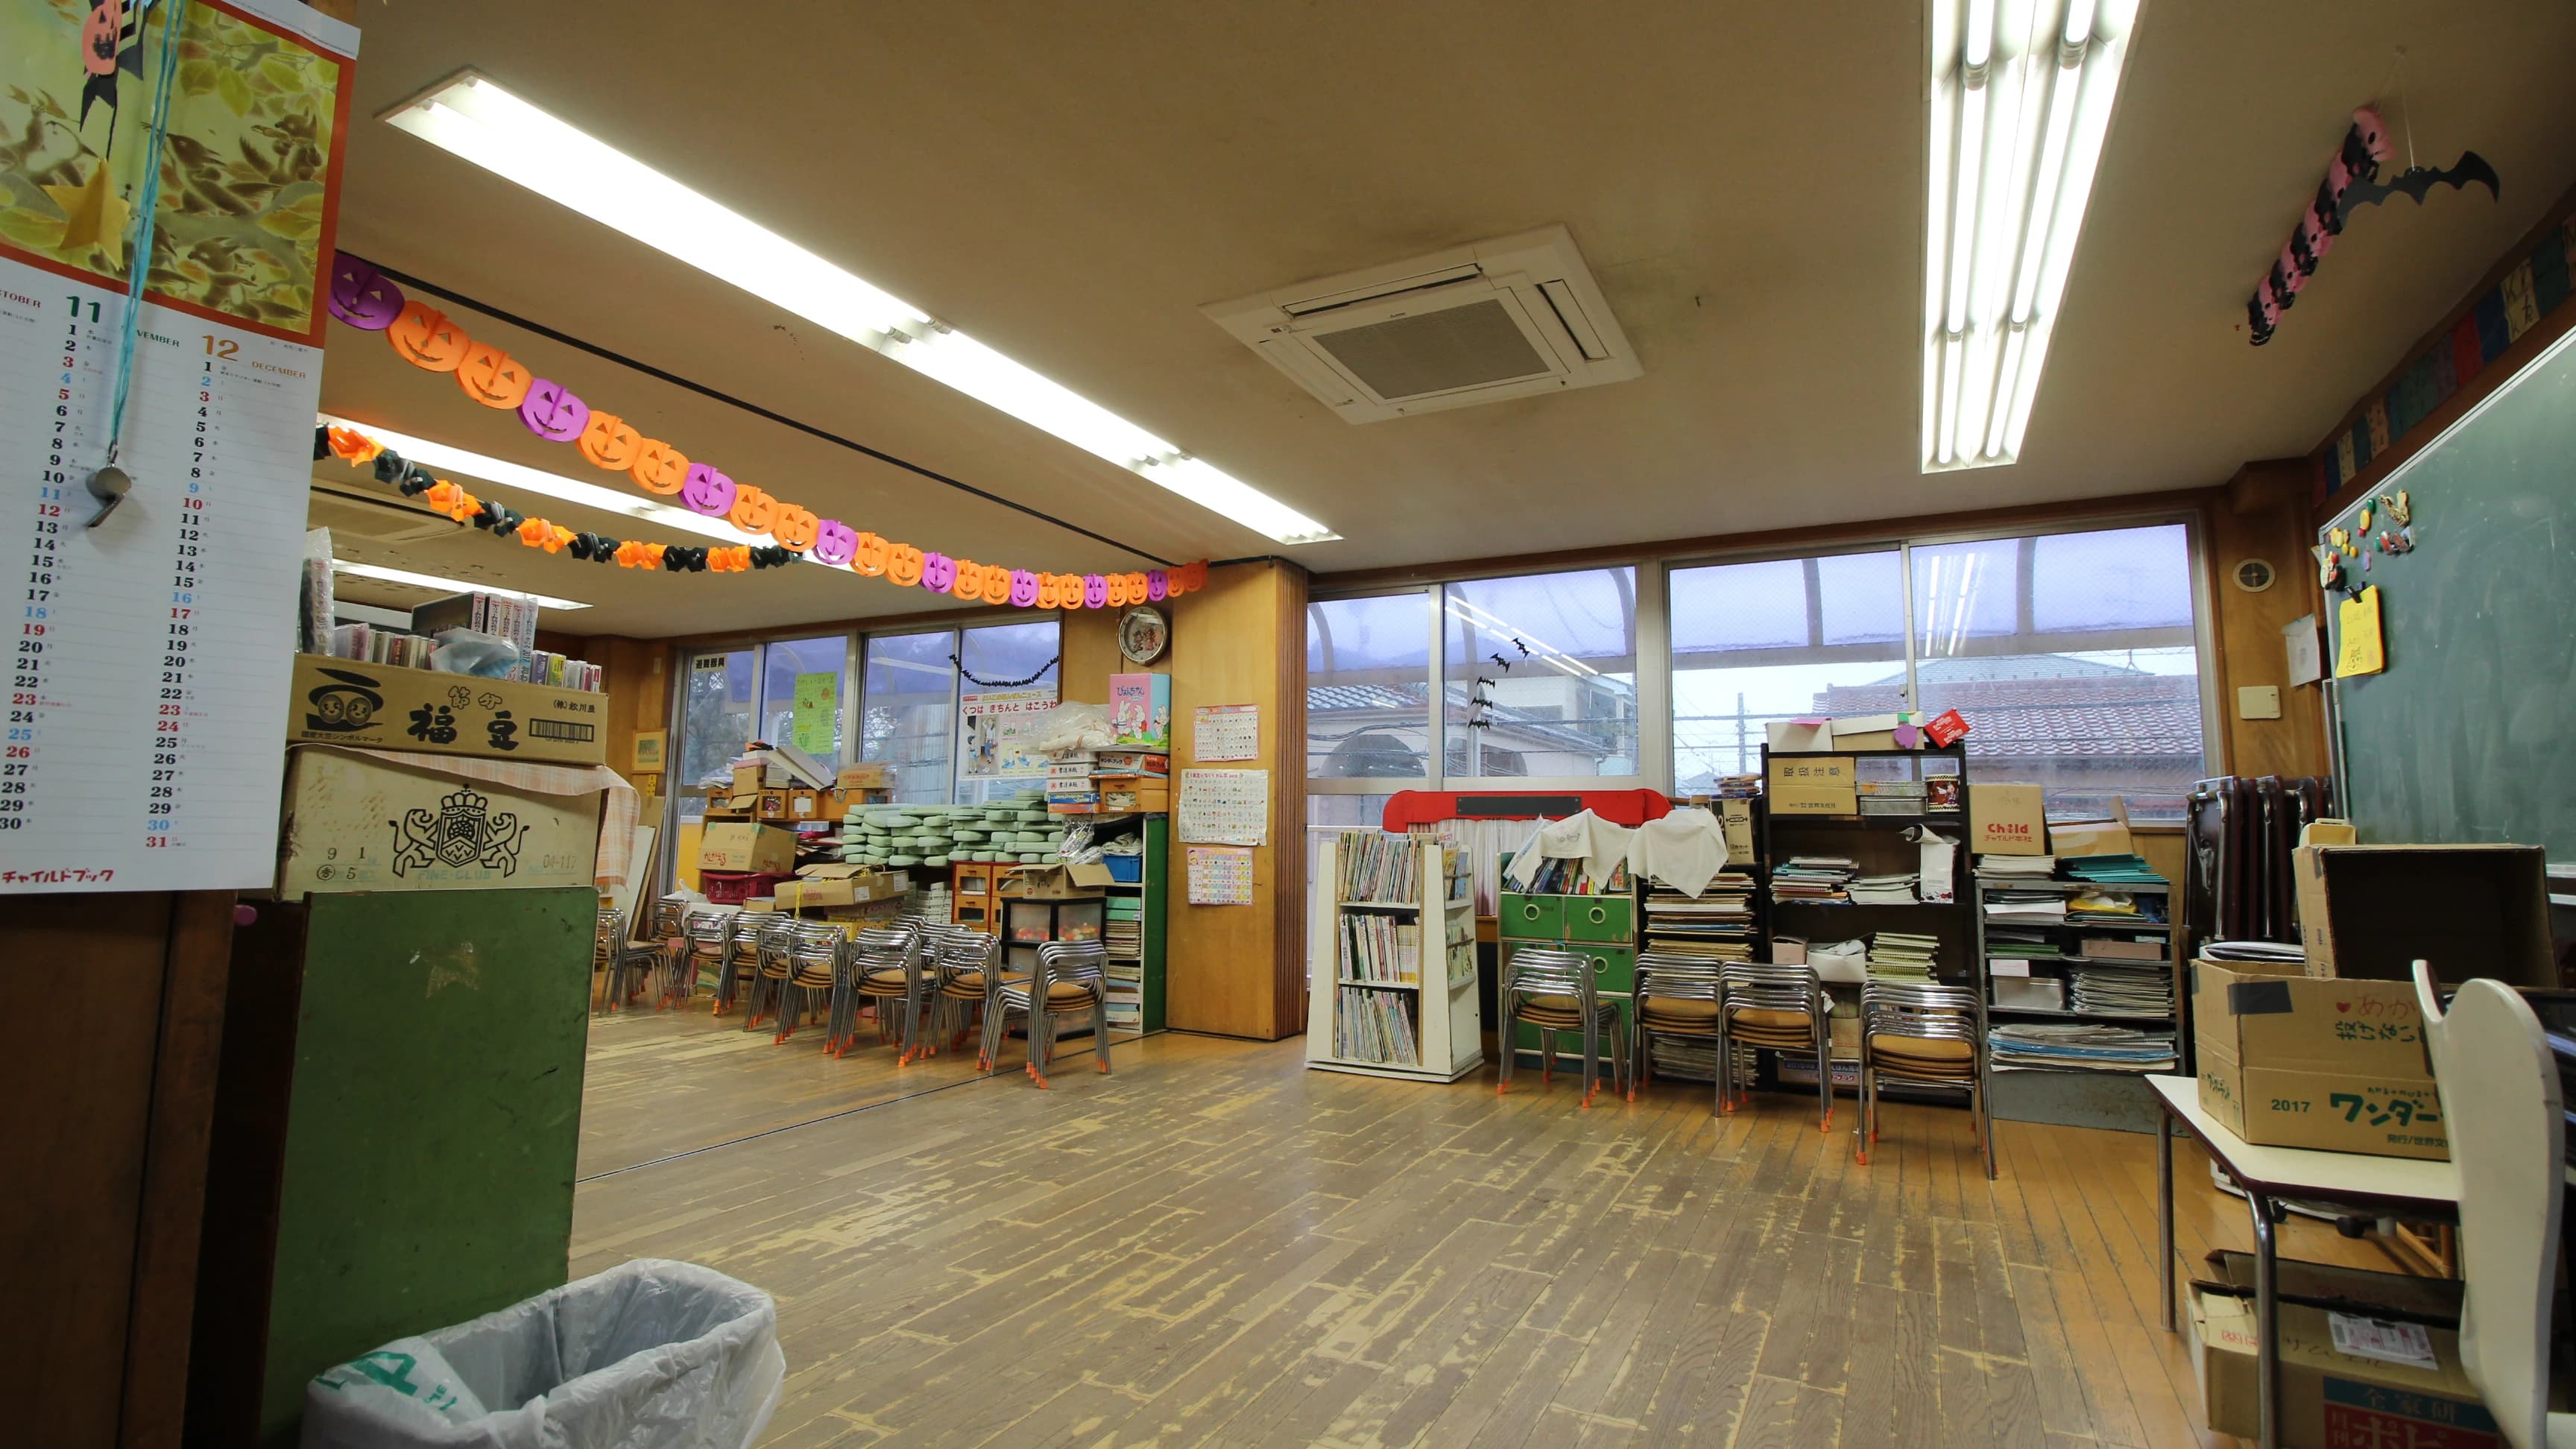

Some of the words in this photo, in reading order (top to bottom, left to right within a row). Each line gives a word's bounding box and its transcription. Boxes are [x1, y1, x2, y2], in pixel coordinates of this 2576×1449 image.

[66, 295, 101, 323] 11
[69, 324, 76, 335] 1
[123, 326, 180, 348] VEMBER
[65, 340, 76, 352] 2
[202, 335, 239, 362] 12
[63, 356, 73, 367] 3
[204, 362, 212, 373] 1
[251, 361, 306, 379] DECEMBER
[60, 373, 71, 384] 4
[201, 376, 210, 386] 2
[58, 388, 69, 400] 5
[200, 391, 209, 402] 3
[56, 405, 67, 416] 6
[198, 407, 207, 417] 4
[54, 421, 66, 432] 7
[196, 421, 206, 432] 5
[51, 438, 63, 449] 8
[195, 437, 204, 447] 6
[50, 455, 60, 465] 9
[193, 451, 203, 462] 7
[42, 470, 64, 483] 10
[191, 467, 201, 478] 8
[41, 487, 60, 500] 11
[189, 483, 199, 493] 9
[183, 498, 203, 510] 10
[38, 504, 60, 517] 12
[181, 514, 199, 525] 11
[36, 521, 57, 534] 13
[179, 529, 199, 541] 12
[34, 537, 55, 551] 14
[177, 545, 197, 556] 13
[31, 555, 54, 567] 15
[176, 561, 195, 572] 14
[30, 572, 51, 584] 16
[174, 576, 194, 587] 15
[27, 589, 50, 602] 17
[172, 593, 192, 604] 16
[25, 606, 46, 619] 18
[171, 608, 191, 619] 17
[23, 624, 45, 636] 19
[168, 624, 189, 635] 18
[19, 640, 42, 653] 20
[167, 640, 187, 651] 19
[16, 658, 39, 671] 21
[164, 656, 186, 667] 20
[14, 675, 38, 688] 22
[162, 672, 183, 684] 21
[12, 692, 36, 705] 23
[160, 688, 182, 699] 22
[449, 685, 503, 710] 節分
[159, 704, 180, 716] 23
[962, 705, 983, 715] くつは
[990, 703, 1019, 713] きちんと
[10, 710, 34, 723] 24
[157, 721, 179, 732] 24
[408, 703, 519, 751] 福豆
[8, 728, 32, 740] 25
[155, 736, 177, 748] 25
[6, 746, 30, 758] 26
[154, 754, 176, 765] 26
[4, 763, 28, 776] 27
[152, 770, 174, 781] 27
[1, 781, 25, 794] 28
[151, 786, 172, 798] 28
[0, 799, 24, 812] 29
[149, 803, 171, 814] 29
[148, 820, 169, 830] 30
[1987, 823, 2028, 834] Child
[146, 836, 166, 847] 31
[328, 847, 337, 859] 9
[359, 847, 365, 859] 1
[2, 868, 114, 883] チャイルドブック
[347, 868, 356, 880] 5
[2271, 1099, 2311, 1113] 2017
[2330, 1093, 2443, 1127] ワンダー
